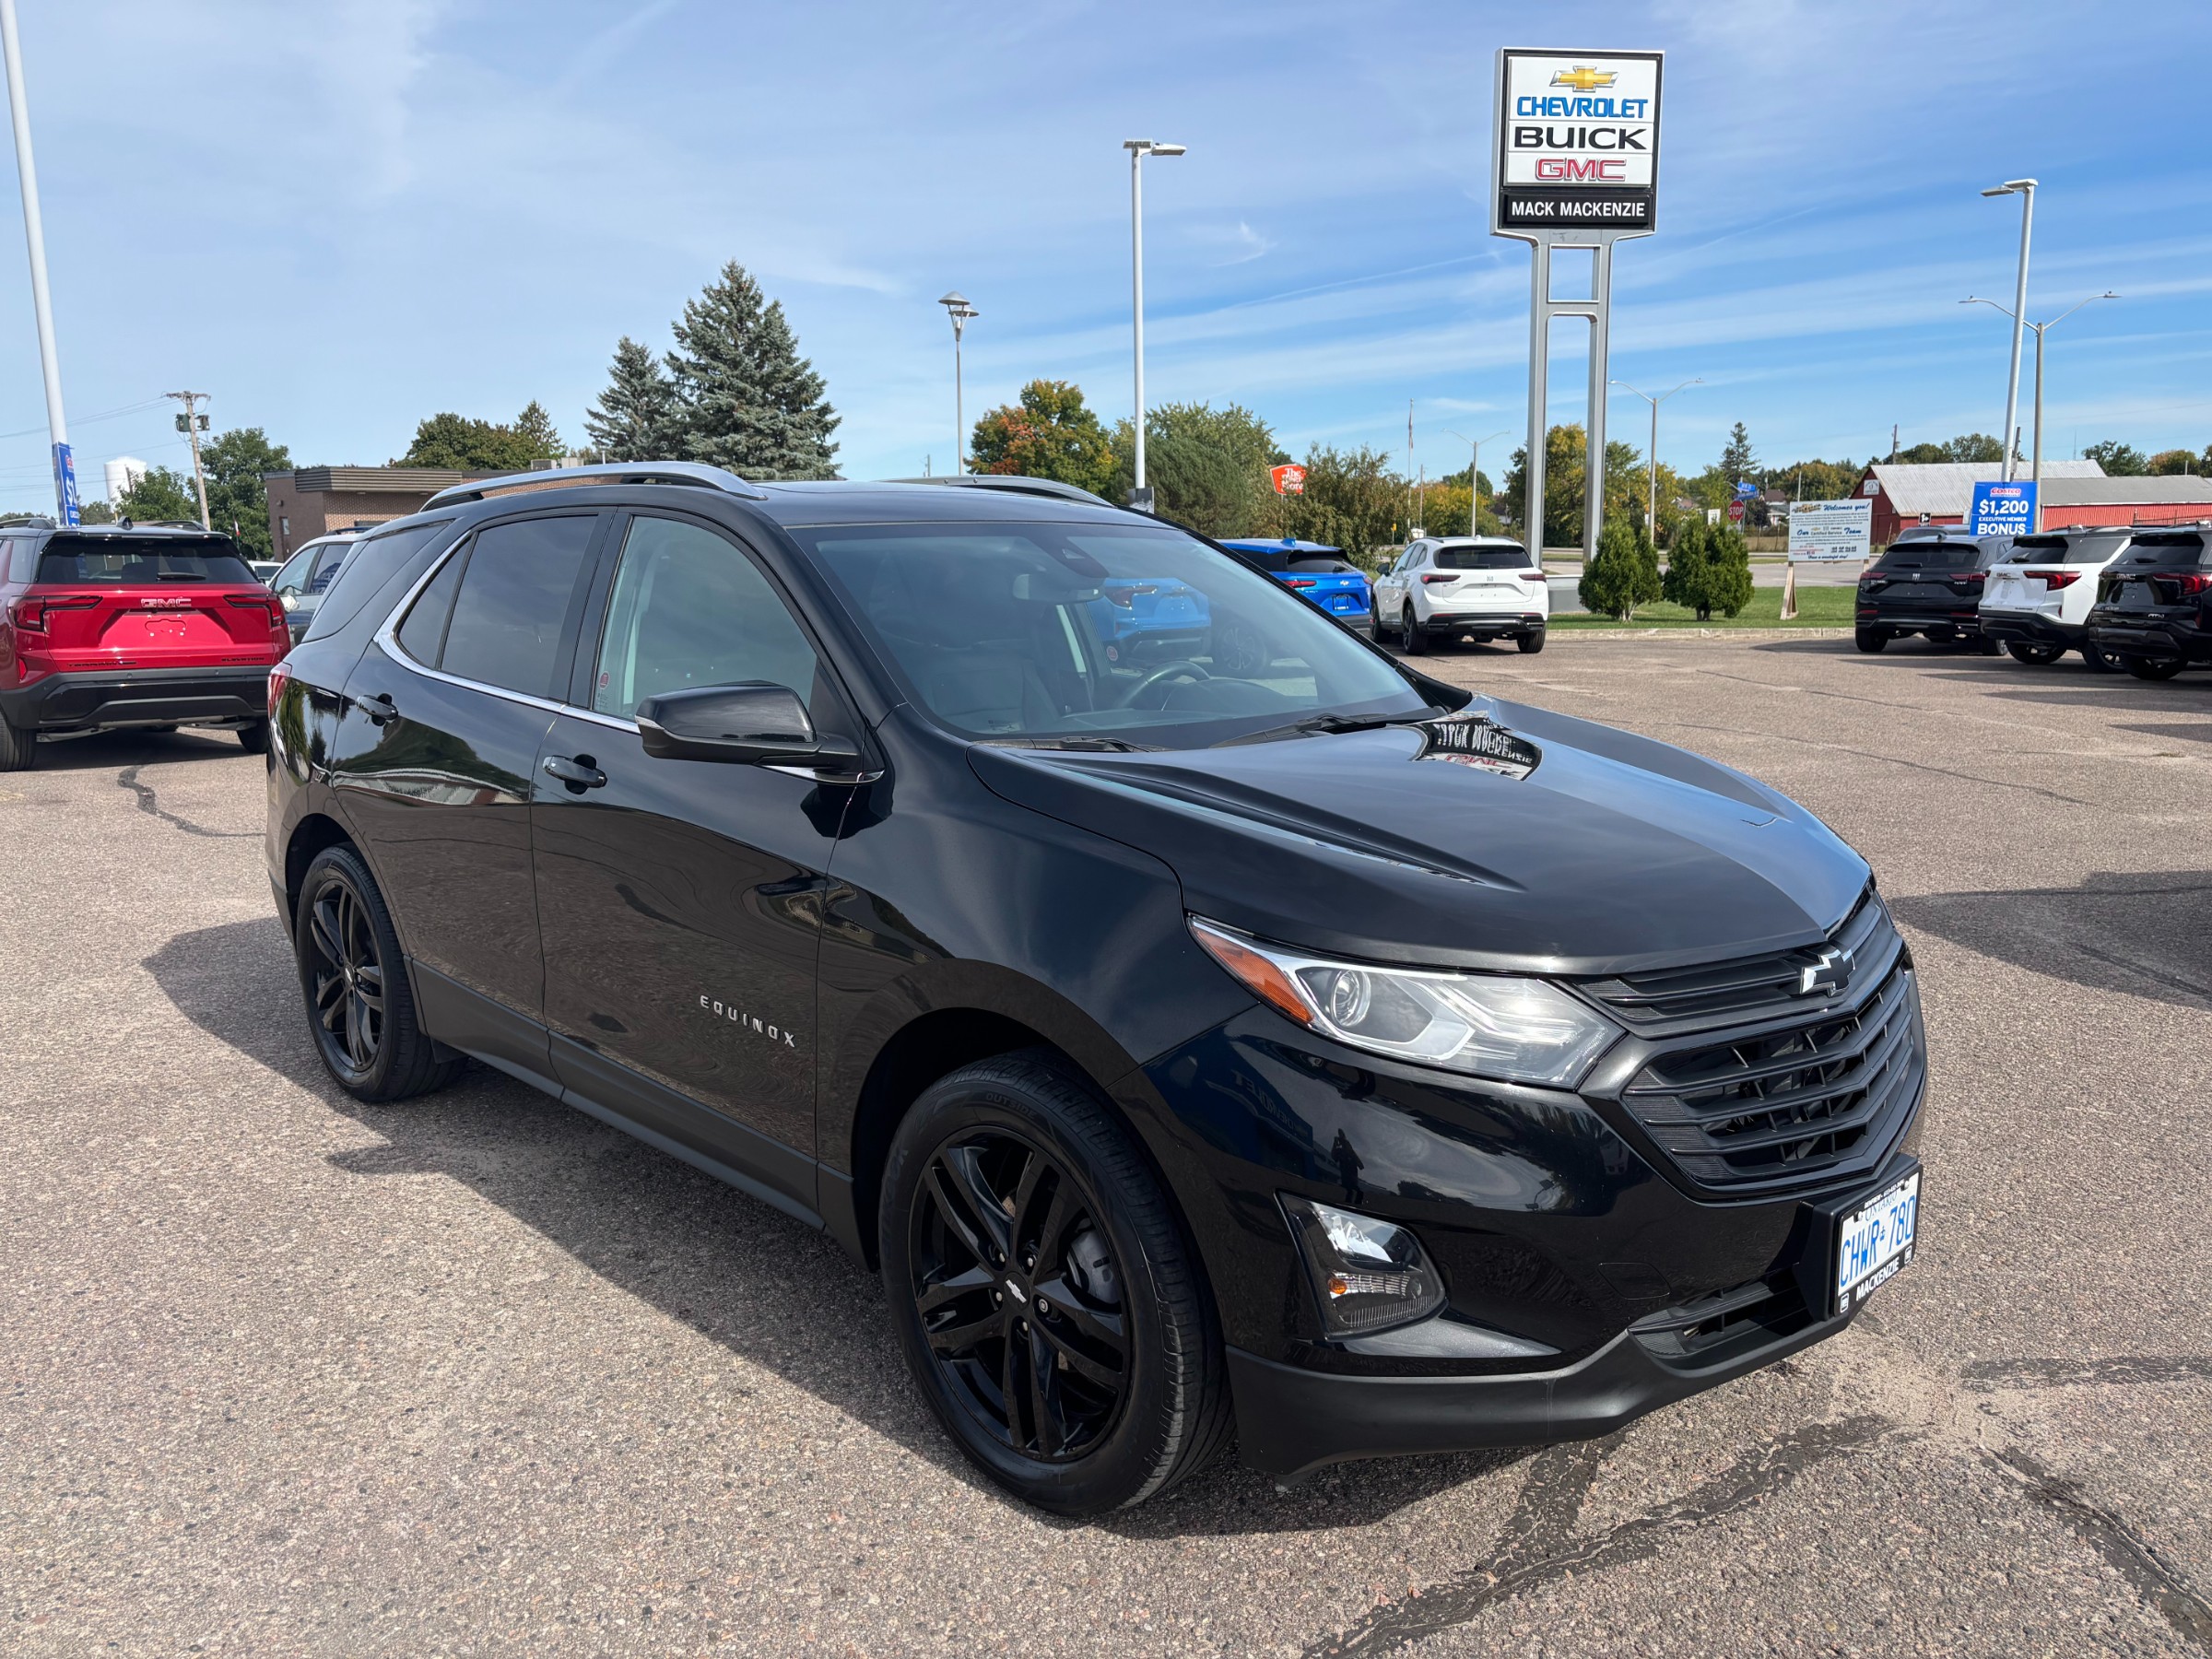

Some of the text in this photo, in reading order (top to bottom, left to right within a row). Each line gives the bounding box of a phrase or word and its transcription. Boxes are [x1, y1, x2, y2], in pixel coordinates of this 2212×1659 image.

[1517, 96, 1648, 118] CHEVROLET
[1514, 126, 1647, 149] BUICK
[1535, 158, 1626, 181] GMC
[1512, 201, 1645, 217] MACK MACKENZIE
[1728, 507, 1744, 516] STOP
[1978, 499, 2029, 516] $1,200
[1977, 523, 2026, 535] BONUS
[141, 598, 192, 608] GMC
[700, 995, 794, 1047] EQUINOX
[986, 1092, 1038, 1119] OUTSIDE
[1841, 1195, 1916, 1288] CHWR 780
[1856, 1256, 1900, 1301] MACKENZIE
